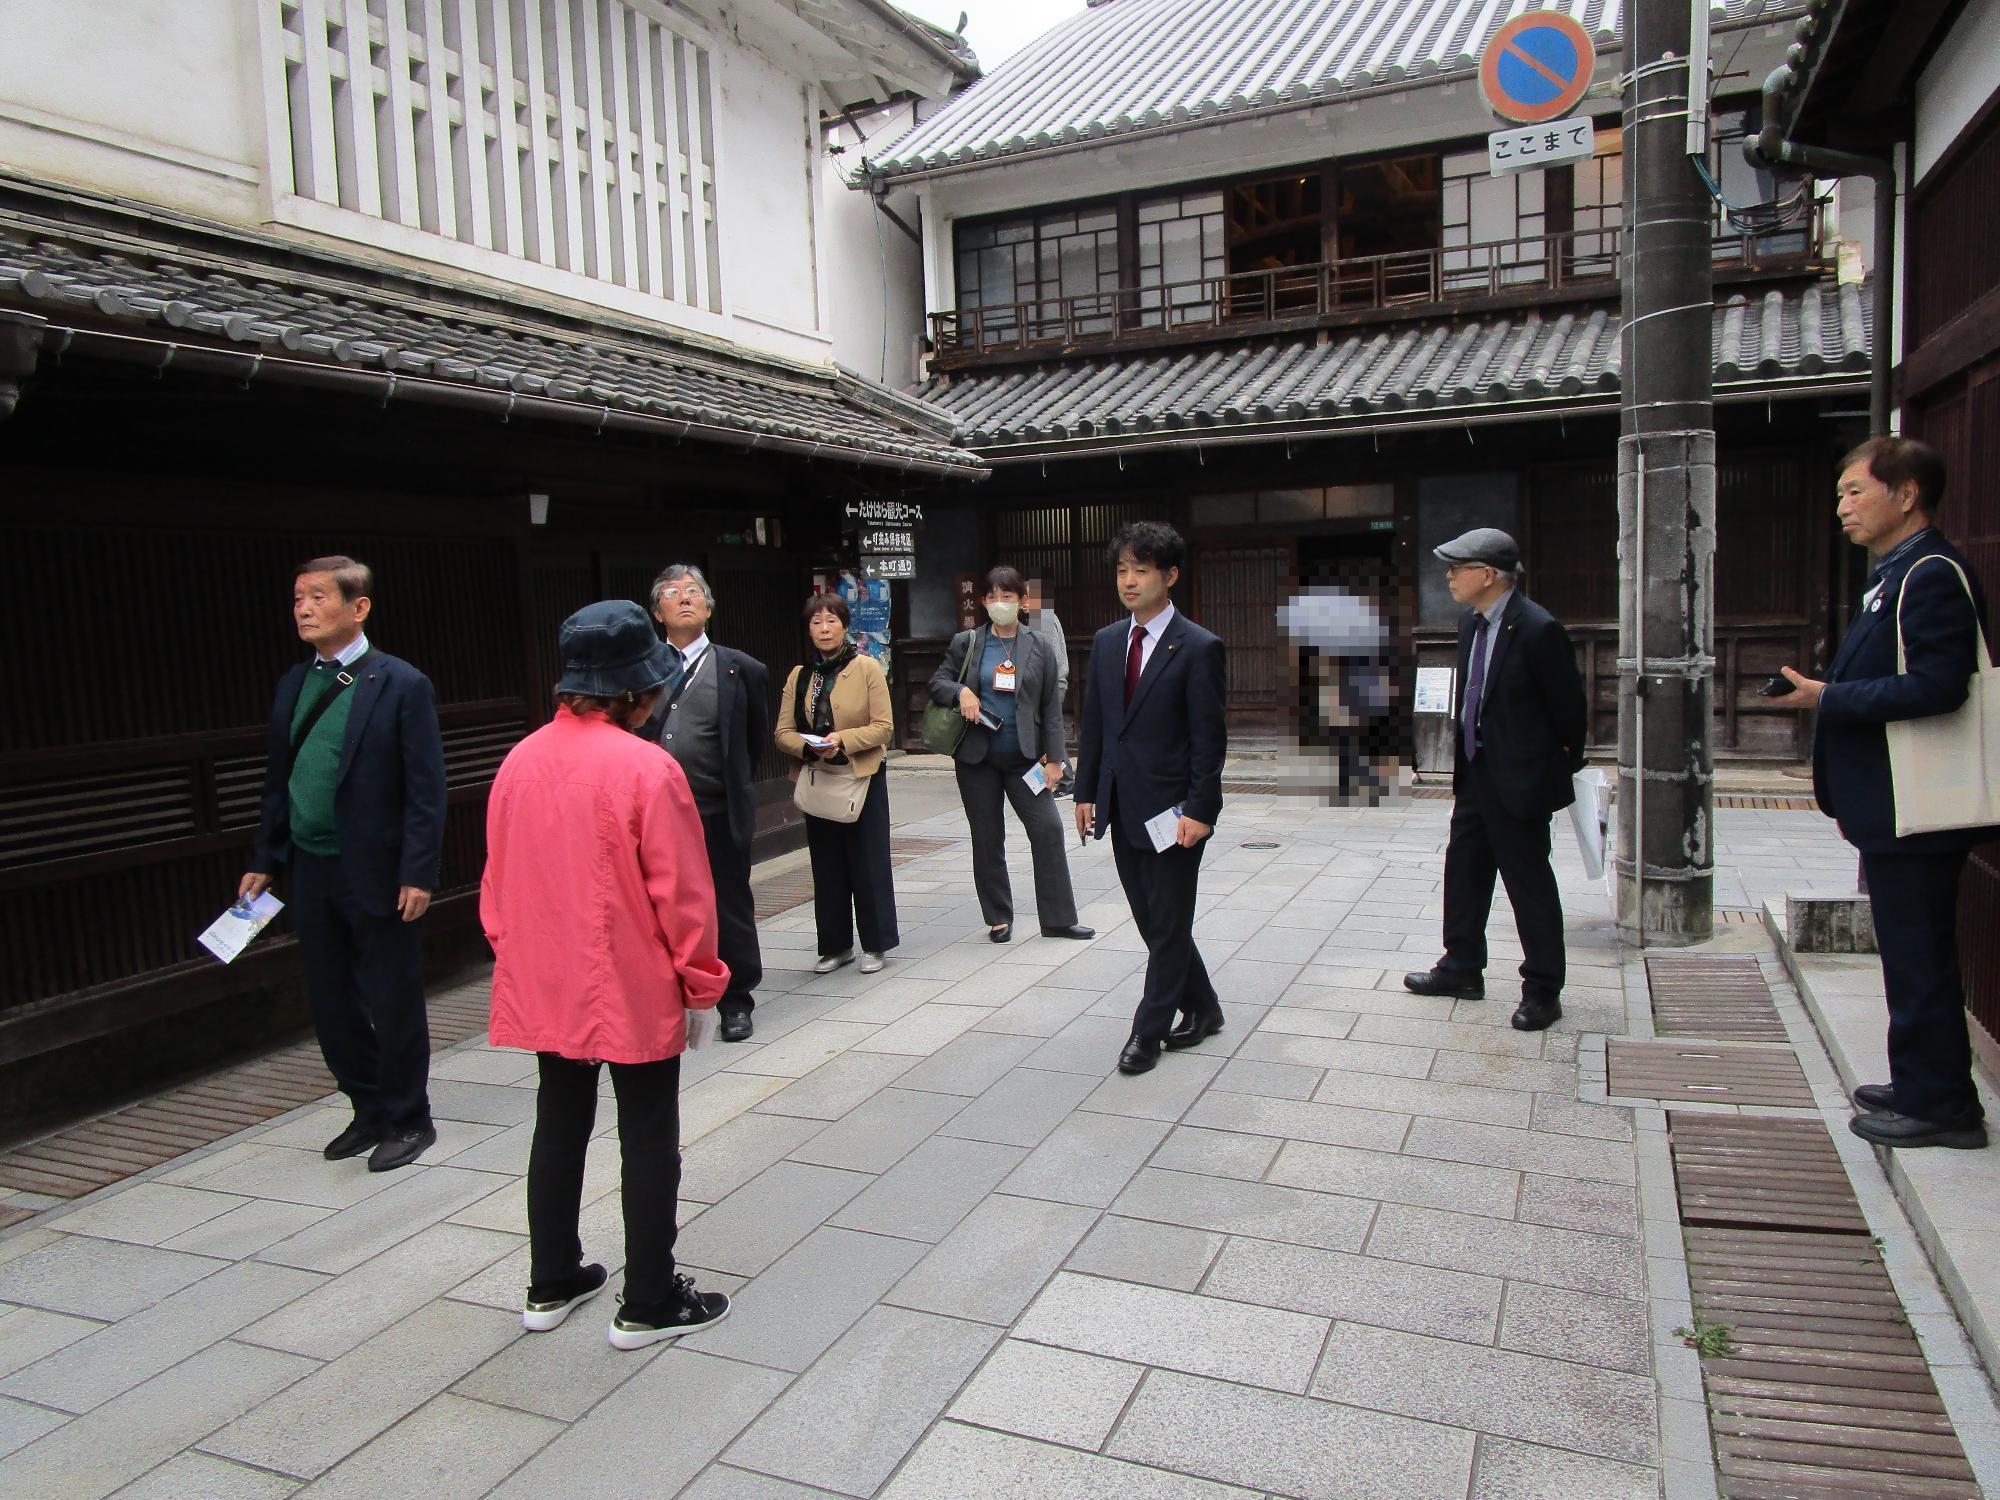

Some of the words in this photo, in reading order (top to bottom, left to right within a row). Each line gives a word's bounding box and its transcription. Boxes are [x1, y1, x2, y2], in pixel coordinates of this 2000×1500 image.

[1495, 125, 1587, 159] ここまで
[859, 500, 923, 520] たけはら観光コース
[879, 559, 912, 572] 本町通り
